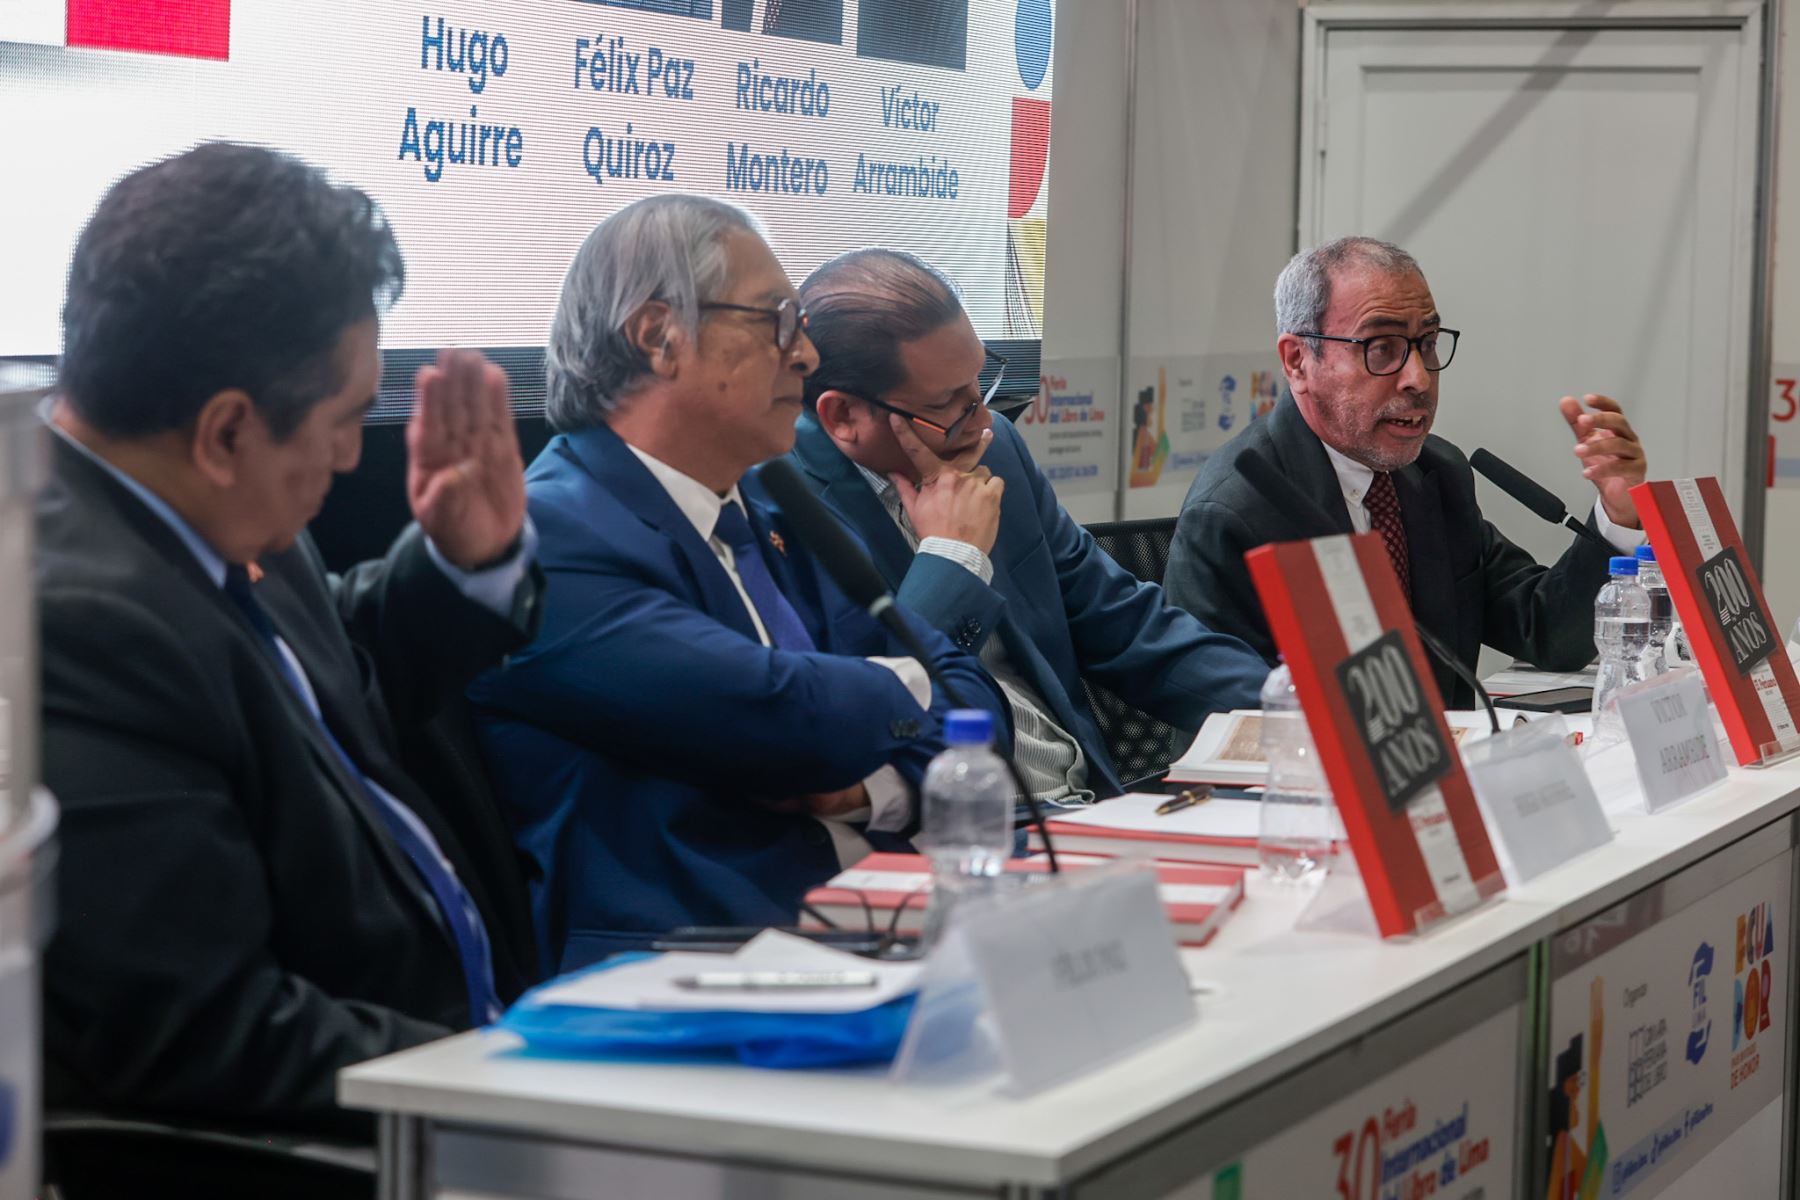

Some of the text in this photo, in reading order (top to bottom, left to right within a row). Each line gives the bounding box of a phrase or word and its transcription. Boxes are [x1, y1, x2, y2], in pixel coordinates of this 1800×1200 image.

[421, 15, 508, 94] Hugo
[574, 34, 694, 101] Félix Paz
[736, 57, 830, 117] Ricardo
[881, 84, 940, 132] Víctor
[399, 104, 523, 182] Aguirre
[583, 122, 674, 184] Quiroz
[726, 142, 828, 195] Montero
[852, 153, 959, 199] Arrambide
[1771, 378, 1800, 423] 3
[1705, 558, 1750, 626] 200
[1730, 611, 1767, 664] AÑOS
[1350, 647, 1419, 743] 200
[1380, 716, 1439, 797] AÑOS
[1333, 1116, 1381, 1200] 30
